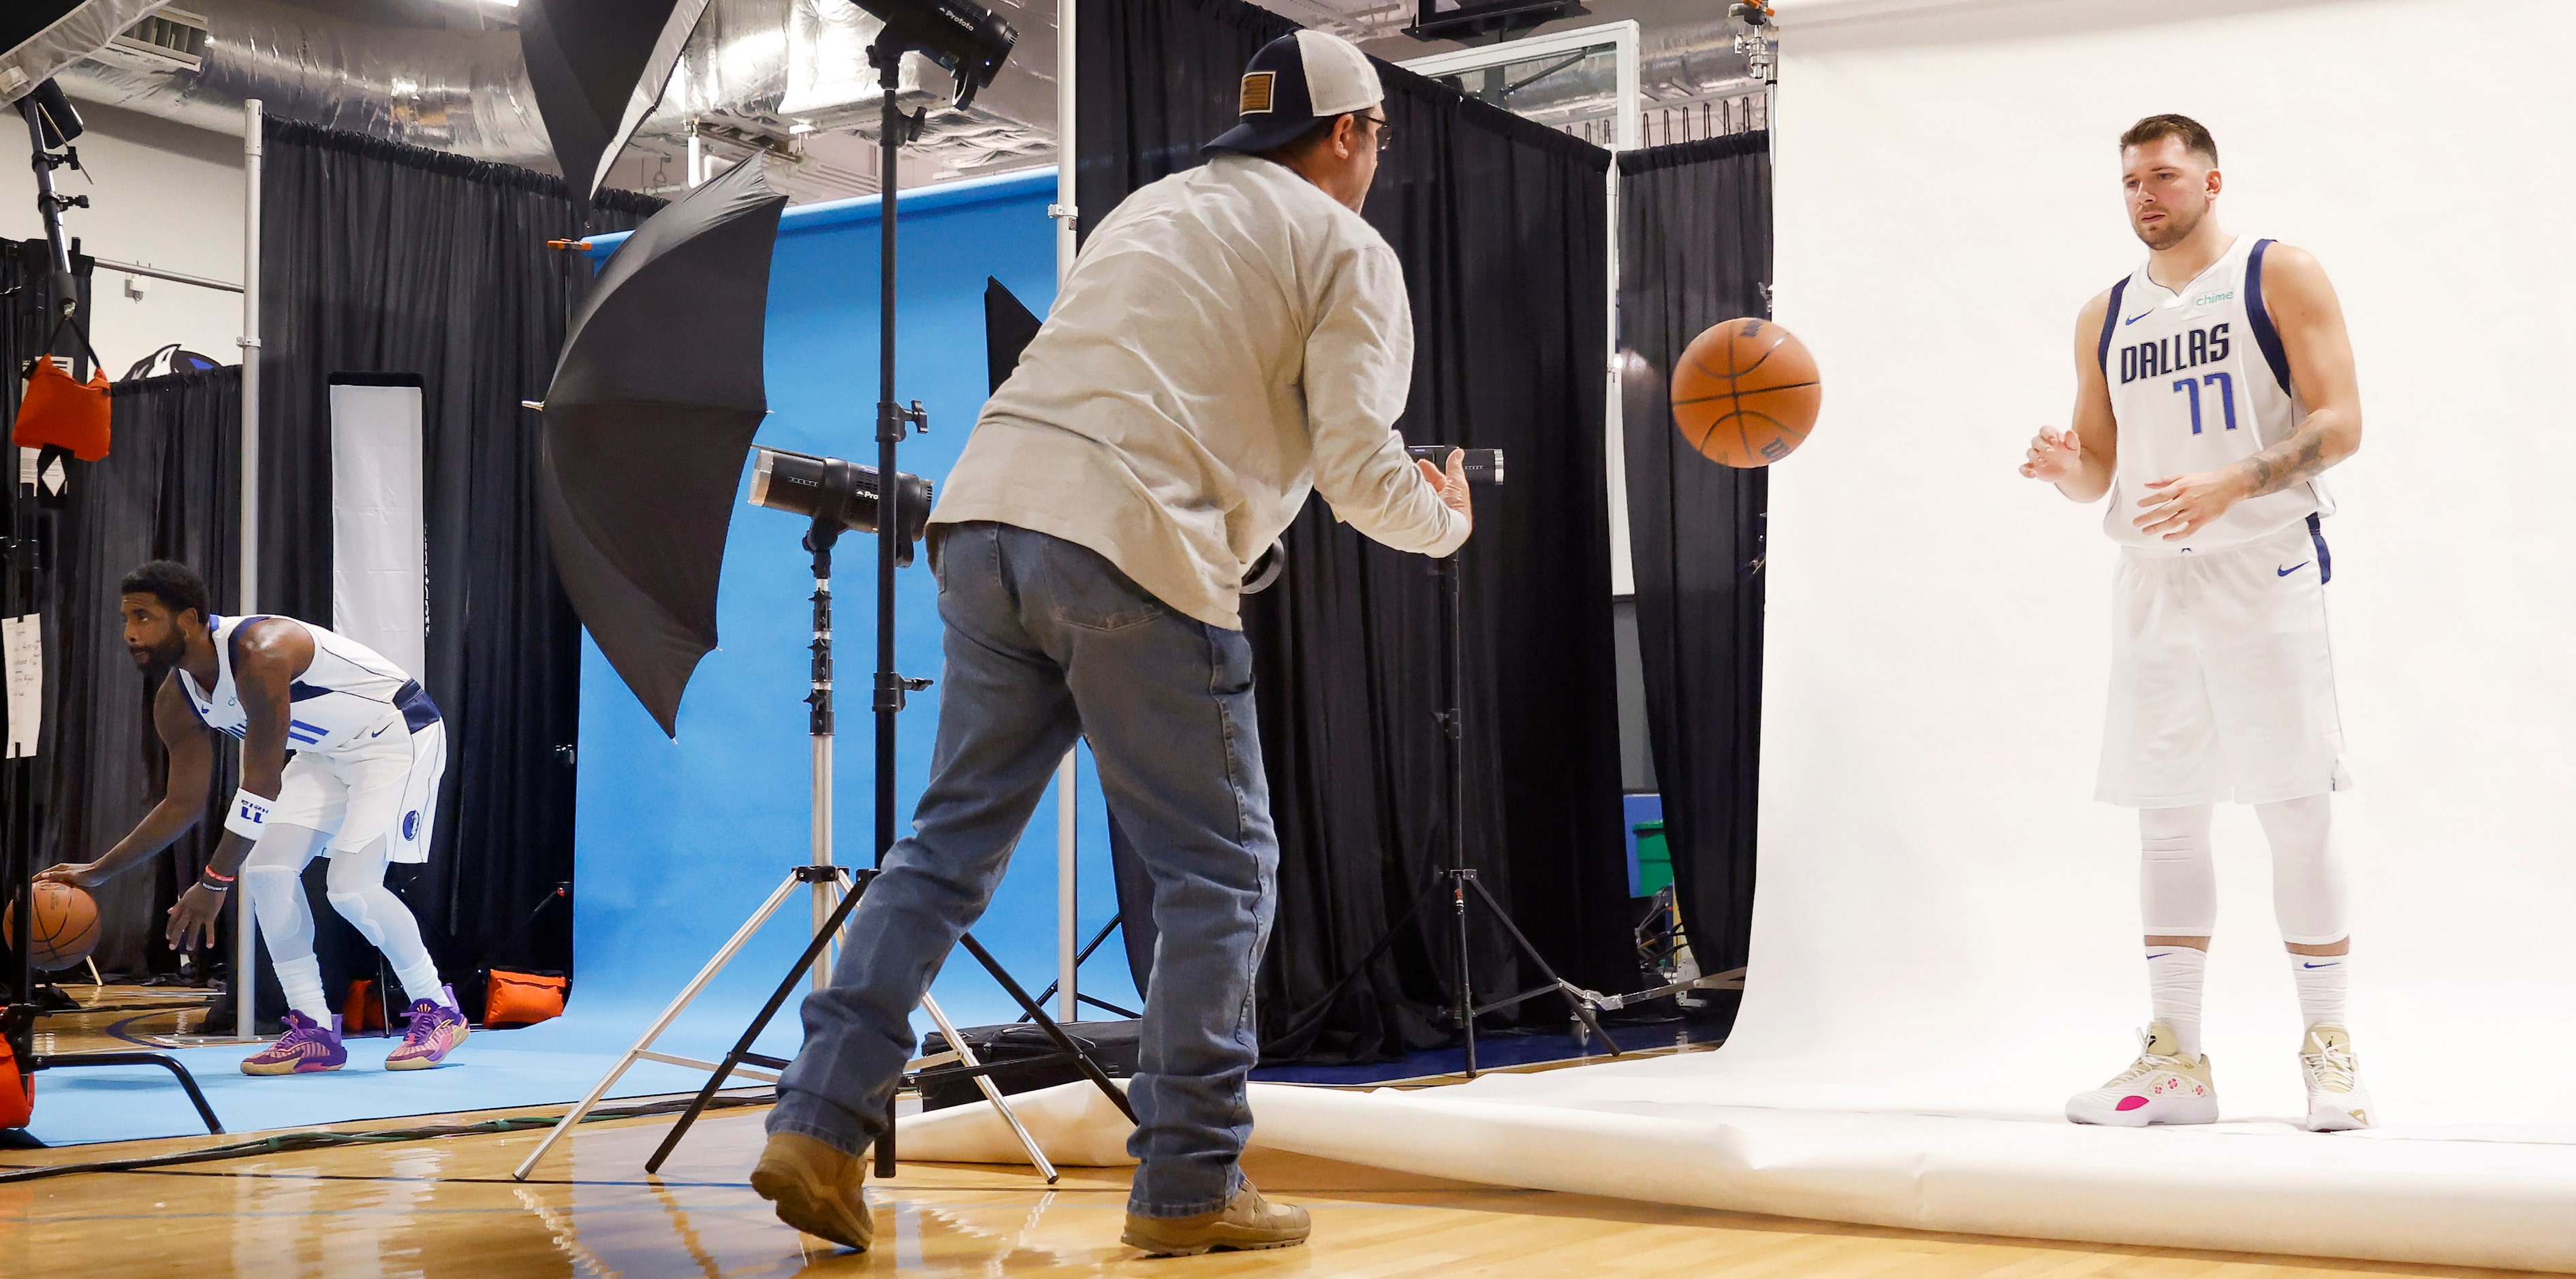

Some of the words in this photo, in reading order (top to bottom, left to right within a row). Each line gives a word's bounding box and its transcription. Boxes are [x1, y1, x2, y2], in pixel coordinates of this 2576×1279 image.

[945, 10, 974, 31] Profoto
[2196, 291, 2234, 306] chime
[2120, 321, 2231, 385] DALLAS
[2172, 371, 2238, 436] 77
